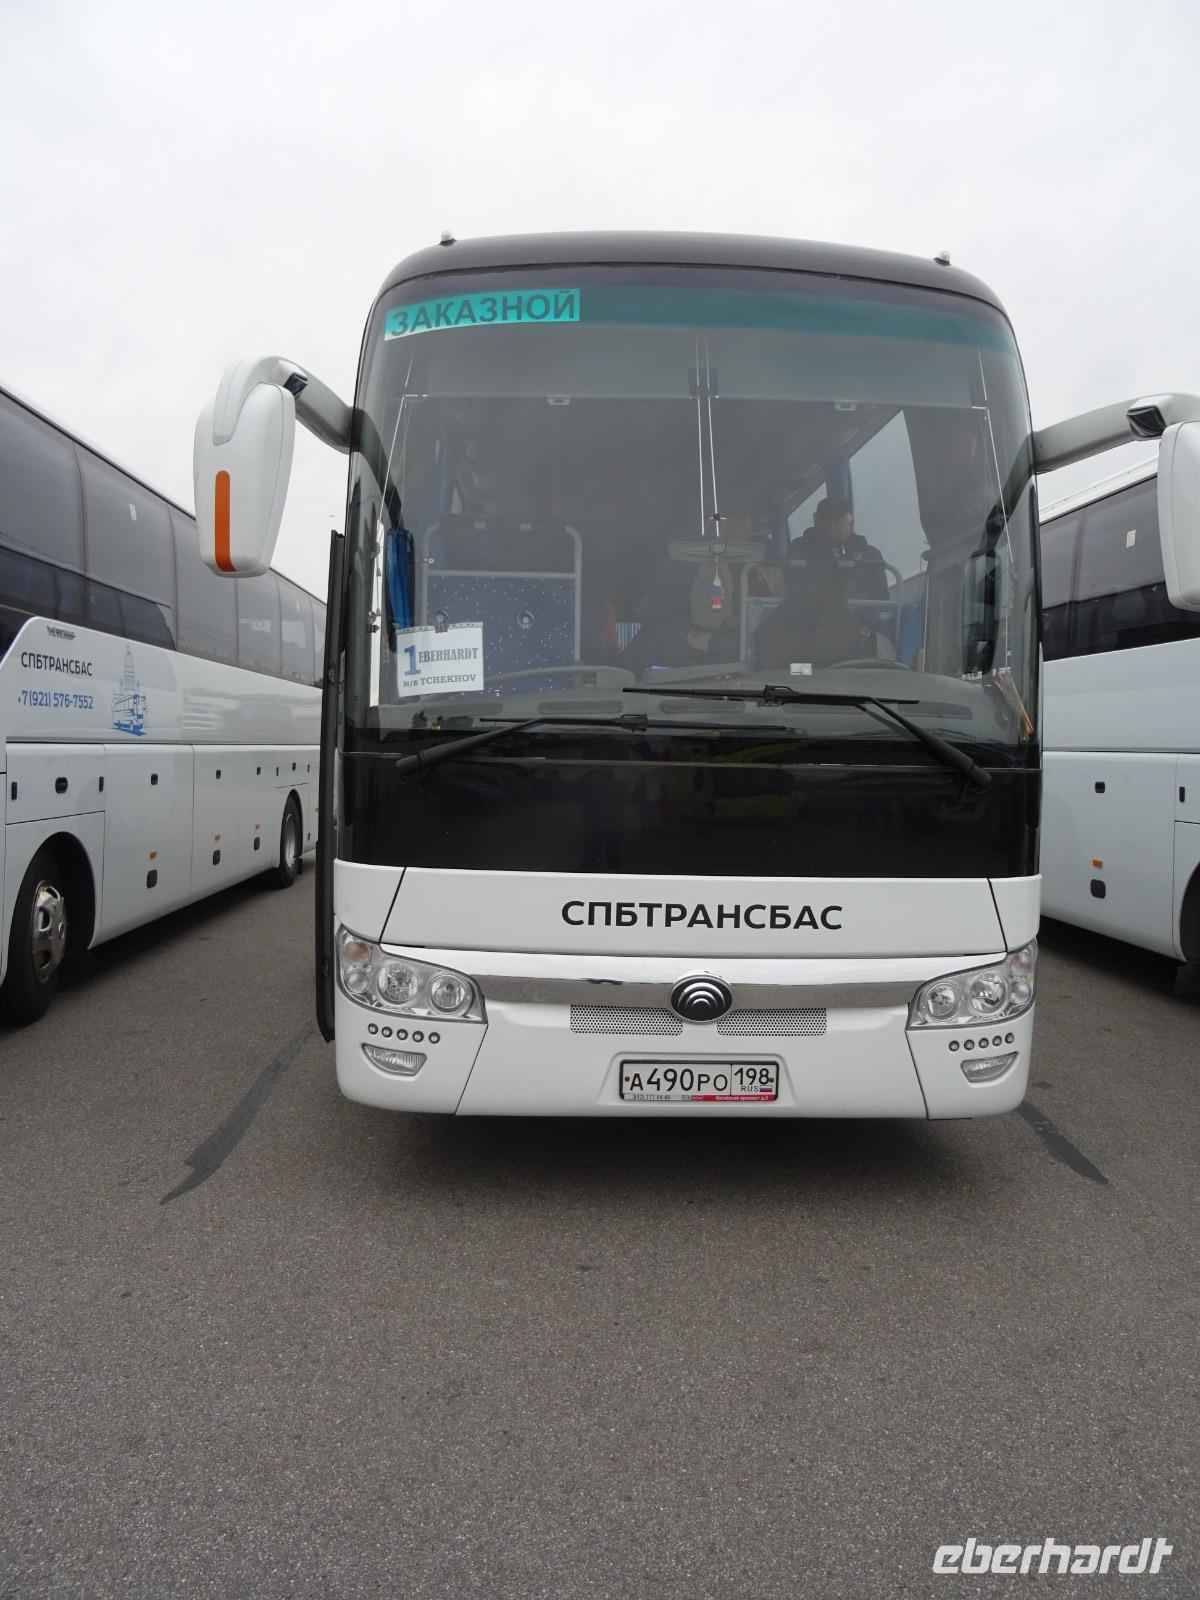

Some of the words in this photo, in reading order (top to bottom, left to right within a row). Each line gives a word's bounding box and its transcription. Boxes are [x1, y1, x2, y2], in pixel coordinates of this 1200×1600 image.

[391, 289, 575, 337] ЗАКАЗНОЙ
[21, 652, 93, 676] СПБТРАНСБАС
[404, 645, 422, 676] 1
[418, 648, 479, 663] EBERHARDT
[420, 674, 476, 685] TCHEKHOV
[53, 692, 94, 709] 576-7552
[561, 900, 843, 930] СПБТРАНСБАС
[734, 1067, 770, 1086] 198
